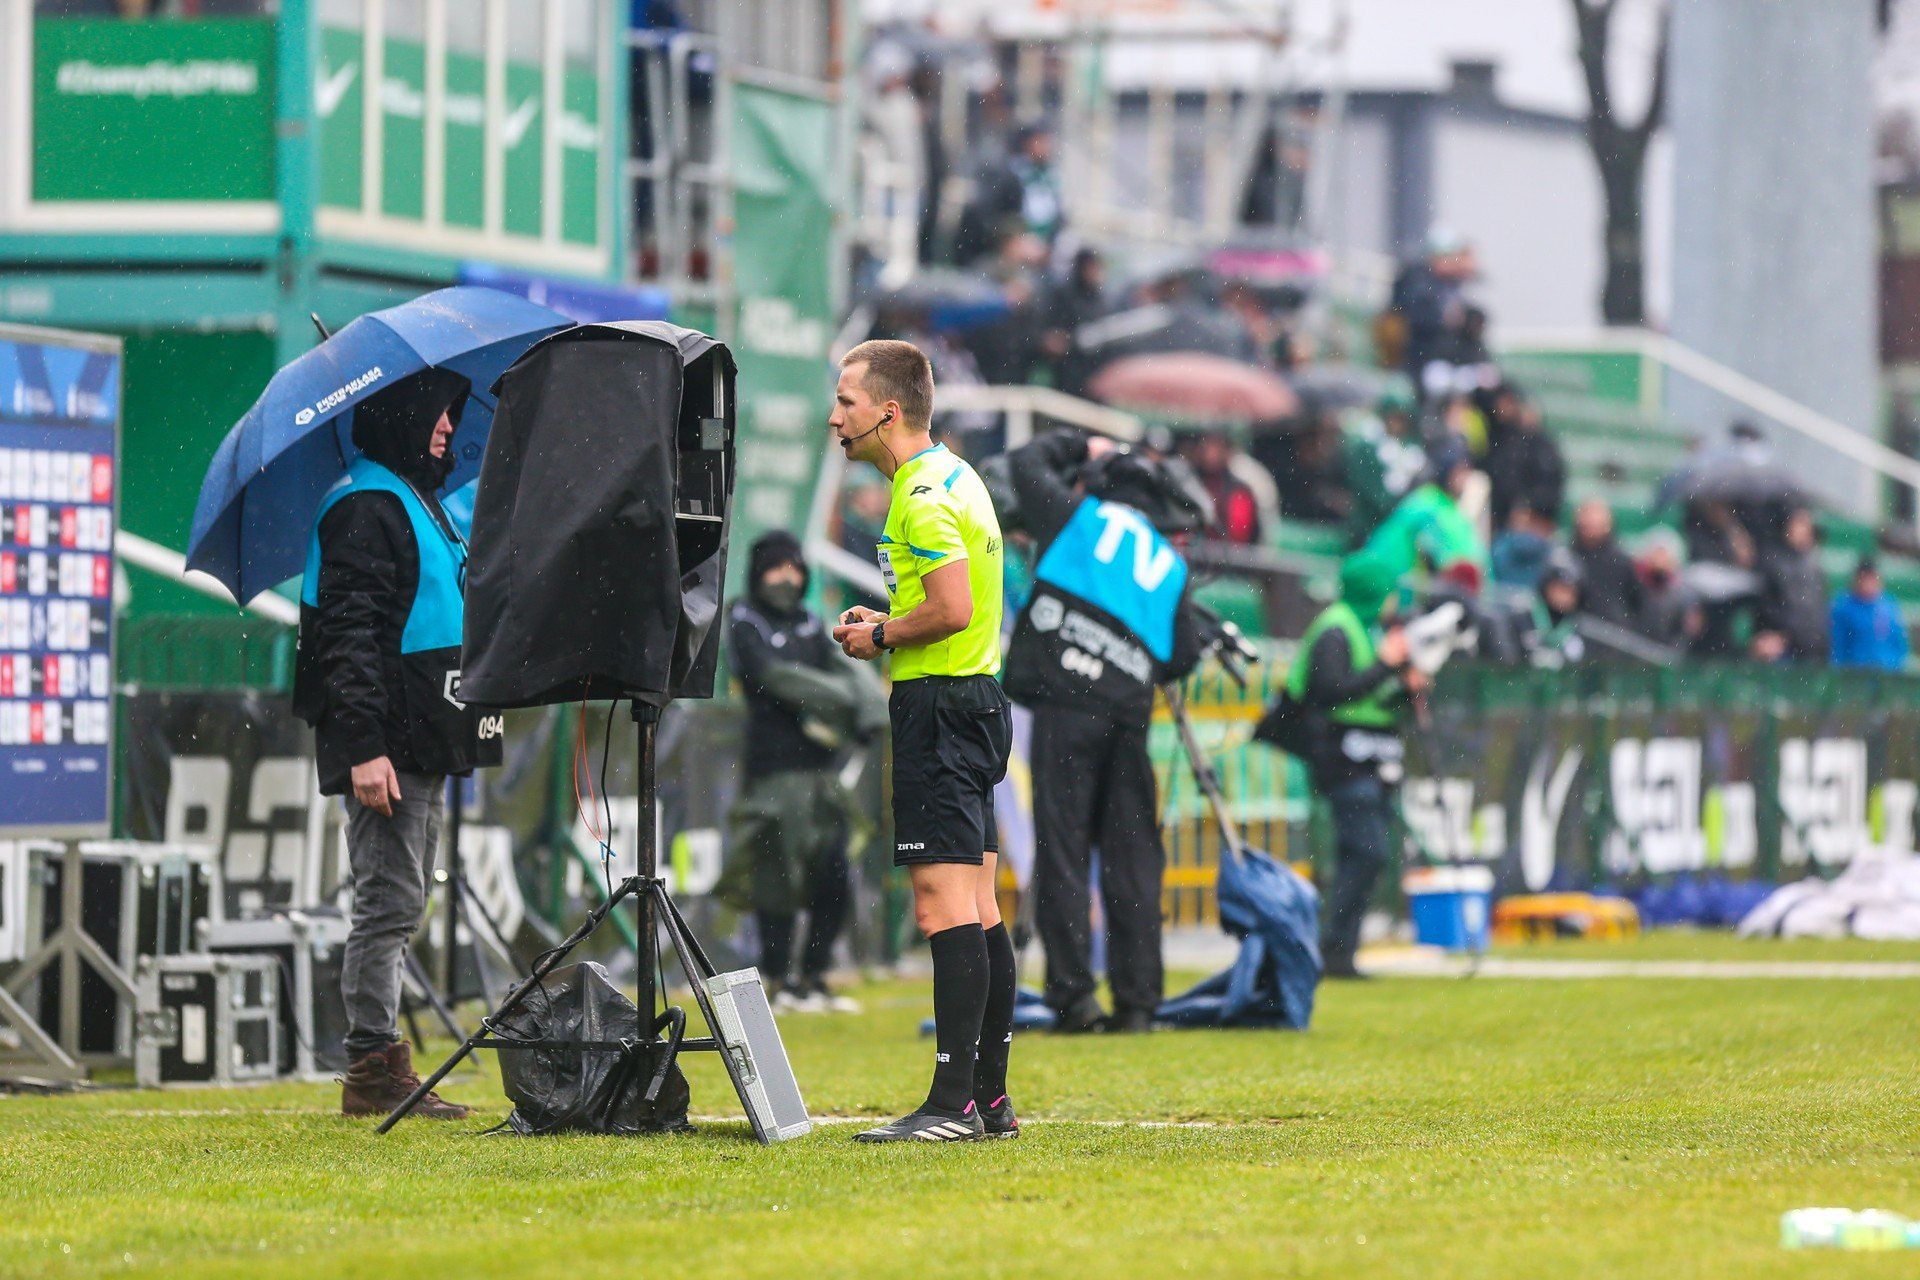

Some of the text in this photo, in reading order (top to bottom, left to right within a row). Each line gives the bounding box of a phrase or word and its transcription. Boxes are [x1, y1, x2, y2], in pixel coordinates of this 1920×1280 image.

[1094, 502, 1175, 592] TV
[478, 715, 504, 739] 094
[897, 842, 925, 850] zina
